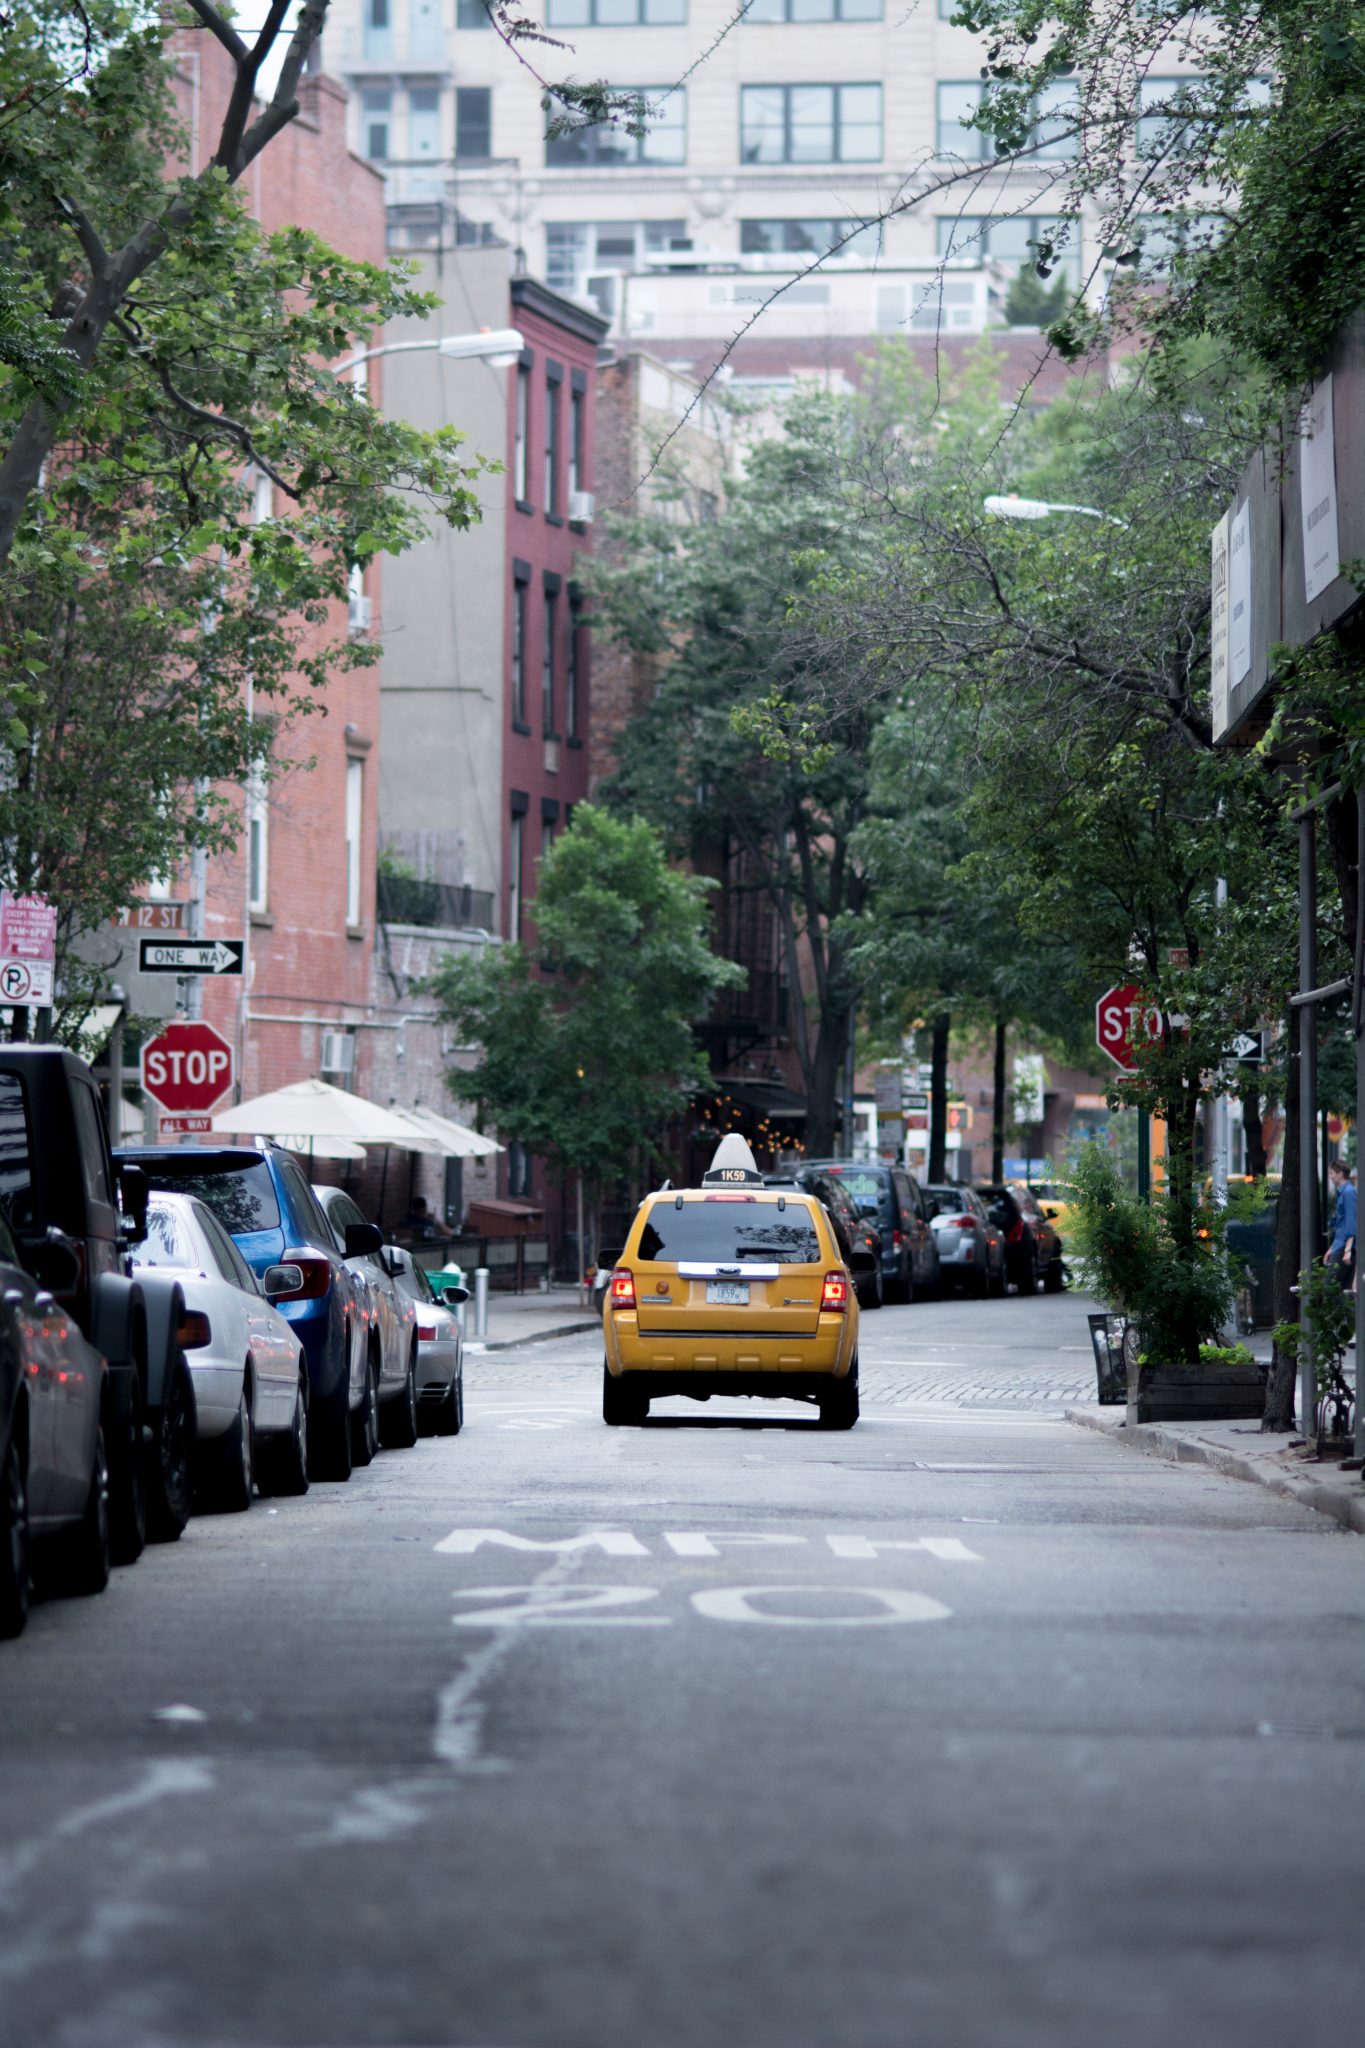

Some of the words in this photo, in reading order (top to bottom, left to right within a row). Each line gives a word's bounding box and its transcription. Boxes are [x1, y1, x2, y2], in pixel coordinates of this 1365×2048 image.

[138, 906, 153, 927] 12
[161, 906, 179, 927] ST
[155, 949, 184, 963] ONE
[199, 950, 228, 965] WAY
[1103, 1006, 1163, 1041] STO
[147, 1050, 229, 1085] STOP
[187, 1118, 209, 1130] WAY
[720, 1170, 746, 1181] 1K59
[432, 1527, 985, 1561] MPH
[451, 1584, 954, 1626] 20
